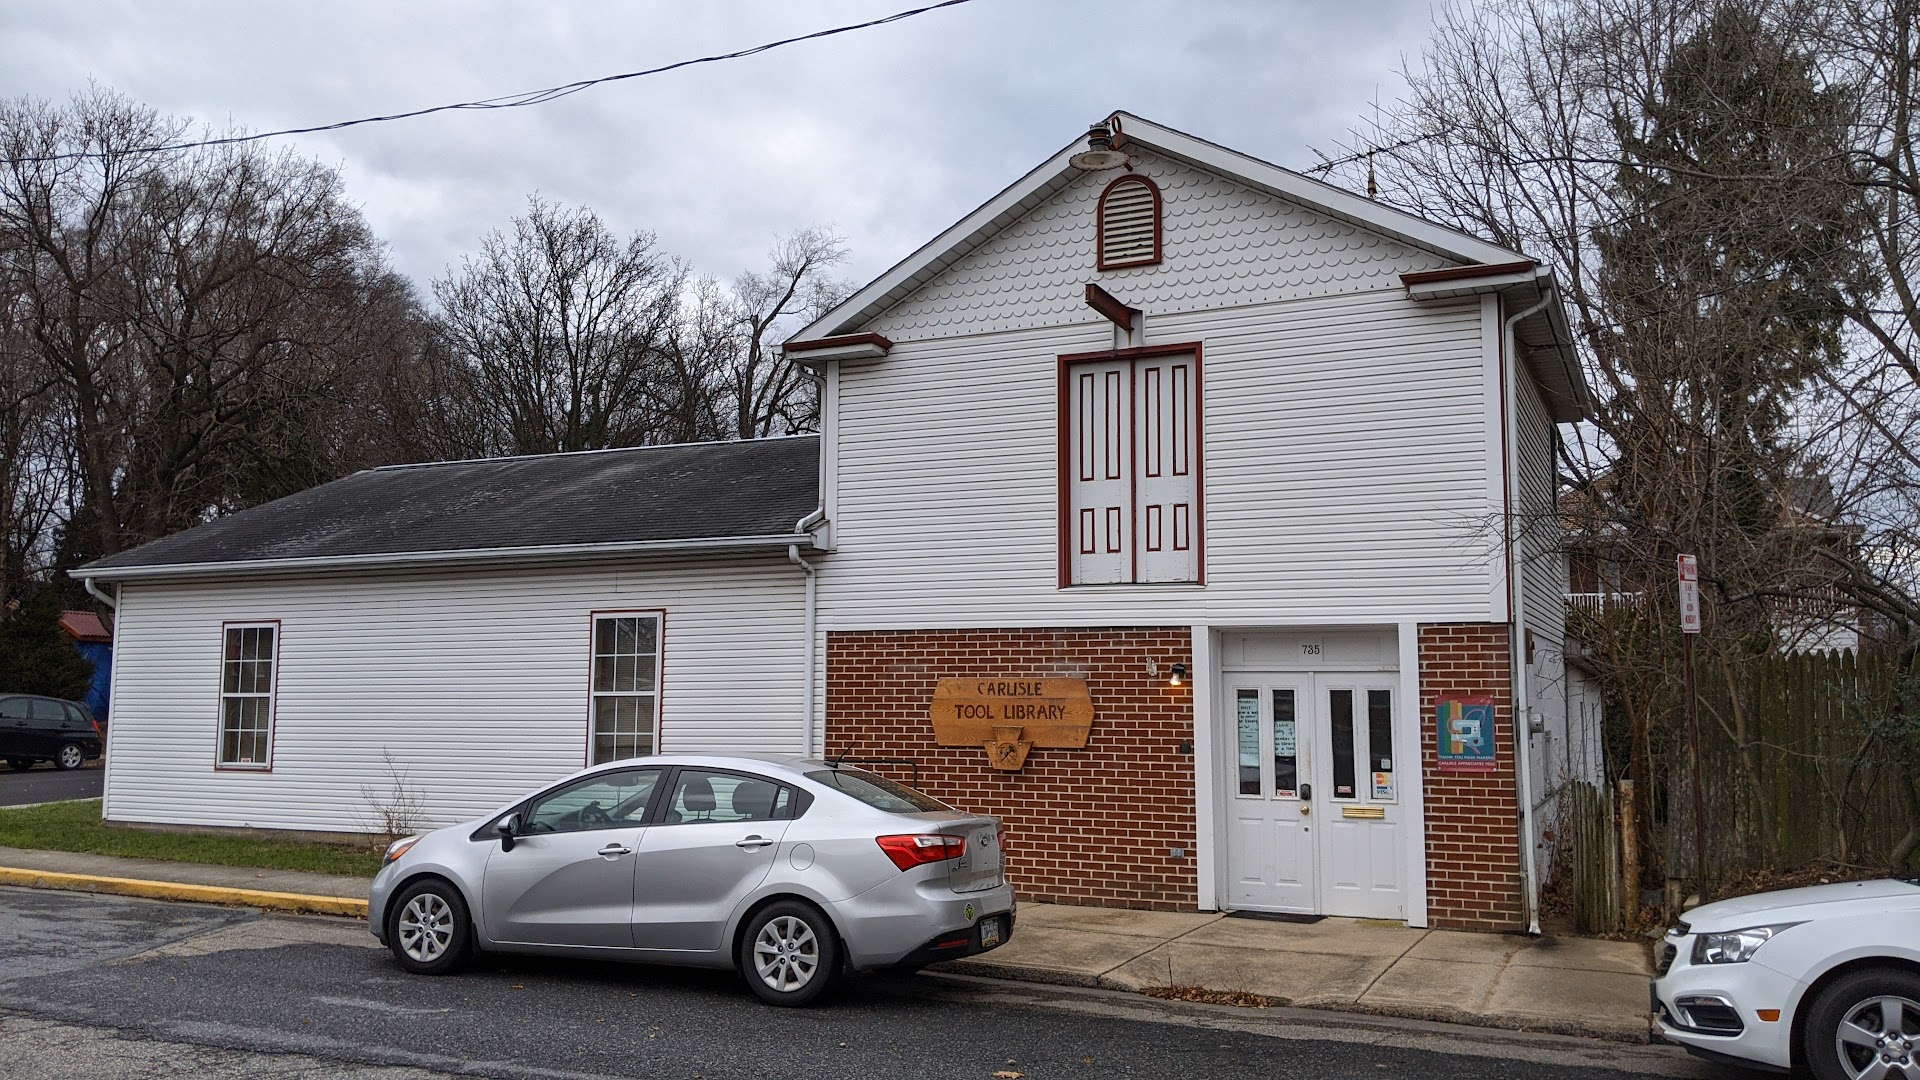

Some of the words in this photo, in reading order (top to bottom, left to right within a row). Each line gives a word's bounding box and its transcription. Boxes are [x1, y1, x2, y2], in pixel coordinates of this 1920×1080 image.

[1302, 644, 1320, 655] 735
[977, 682, 1043, 697] CARLISLE
[954, 704, 995, 720] TOOL
[1004, 704, 1066, 720] LIBRARY
